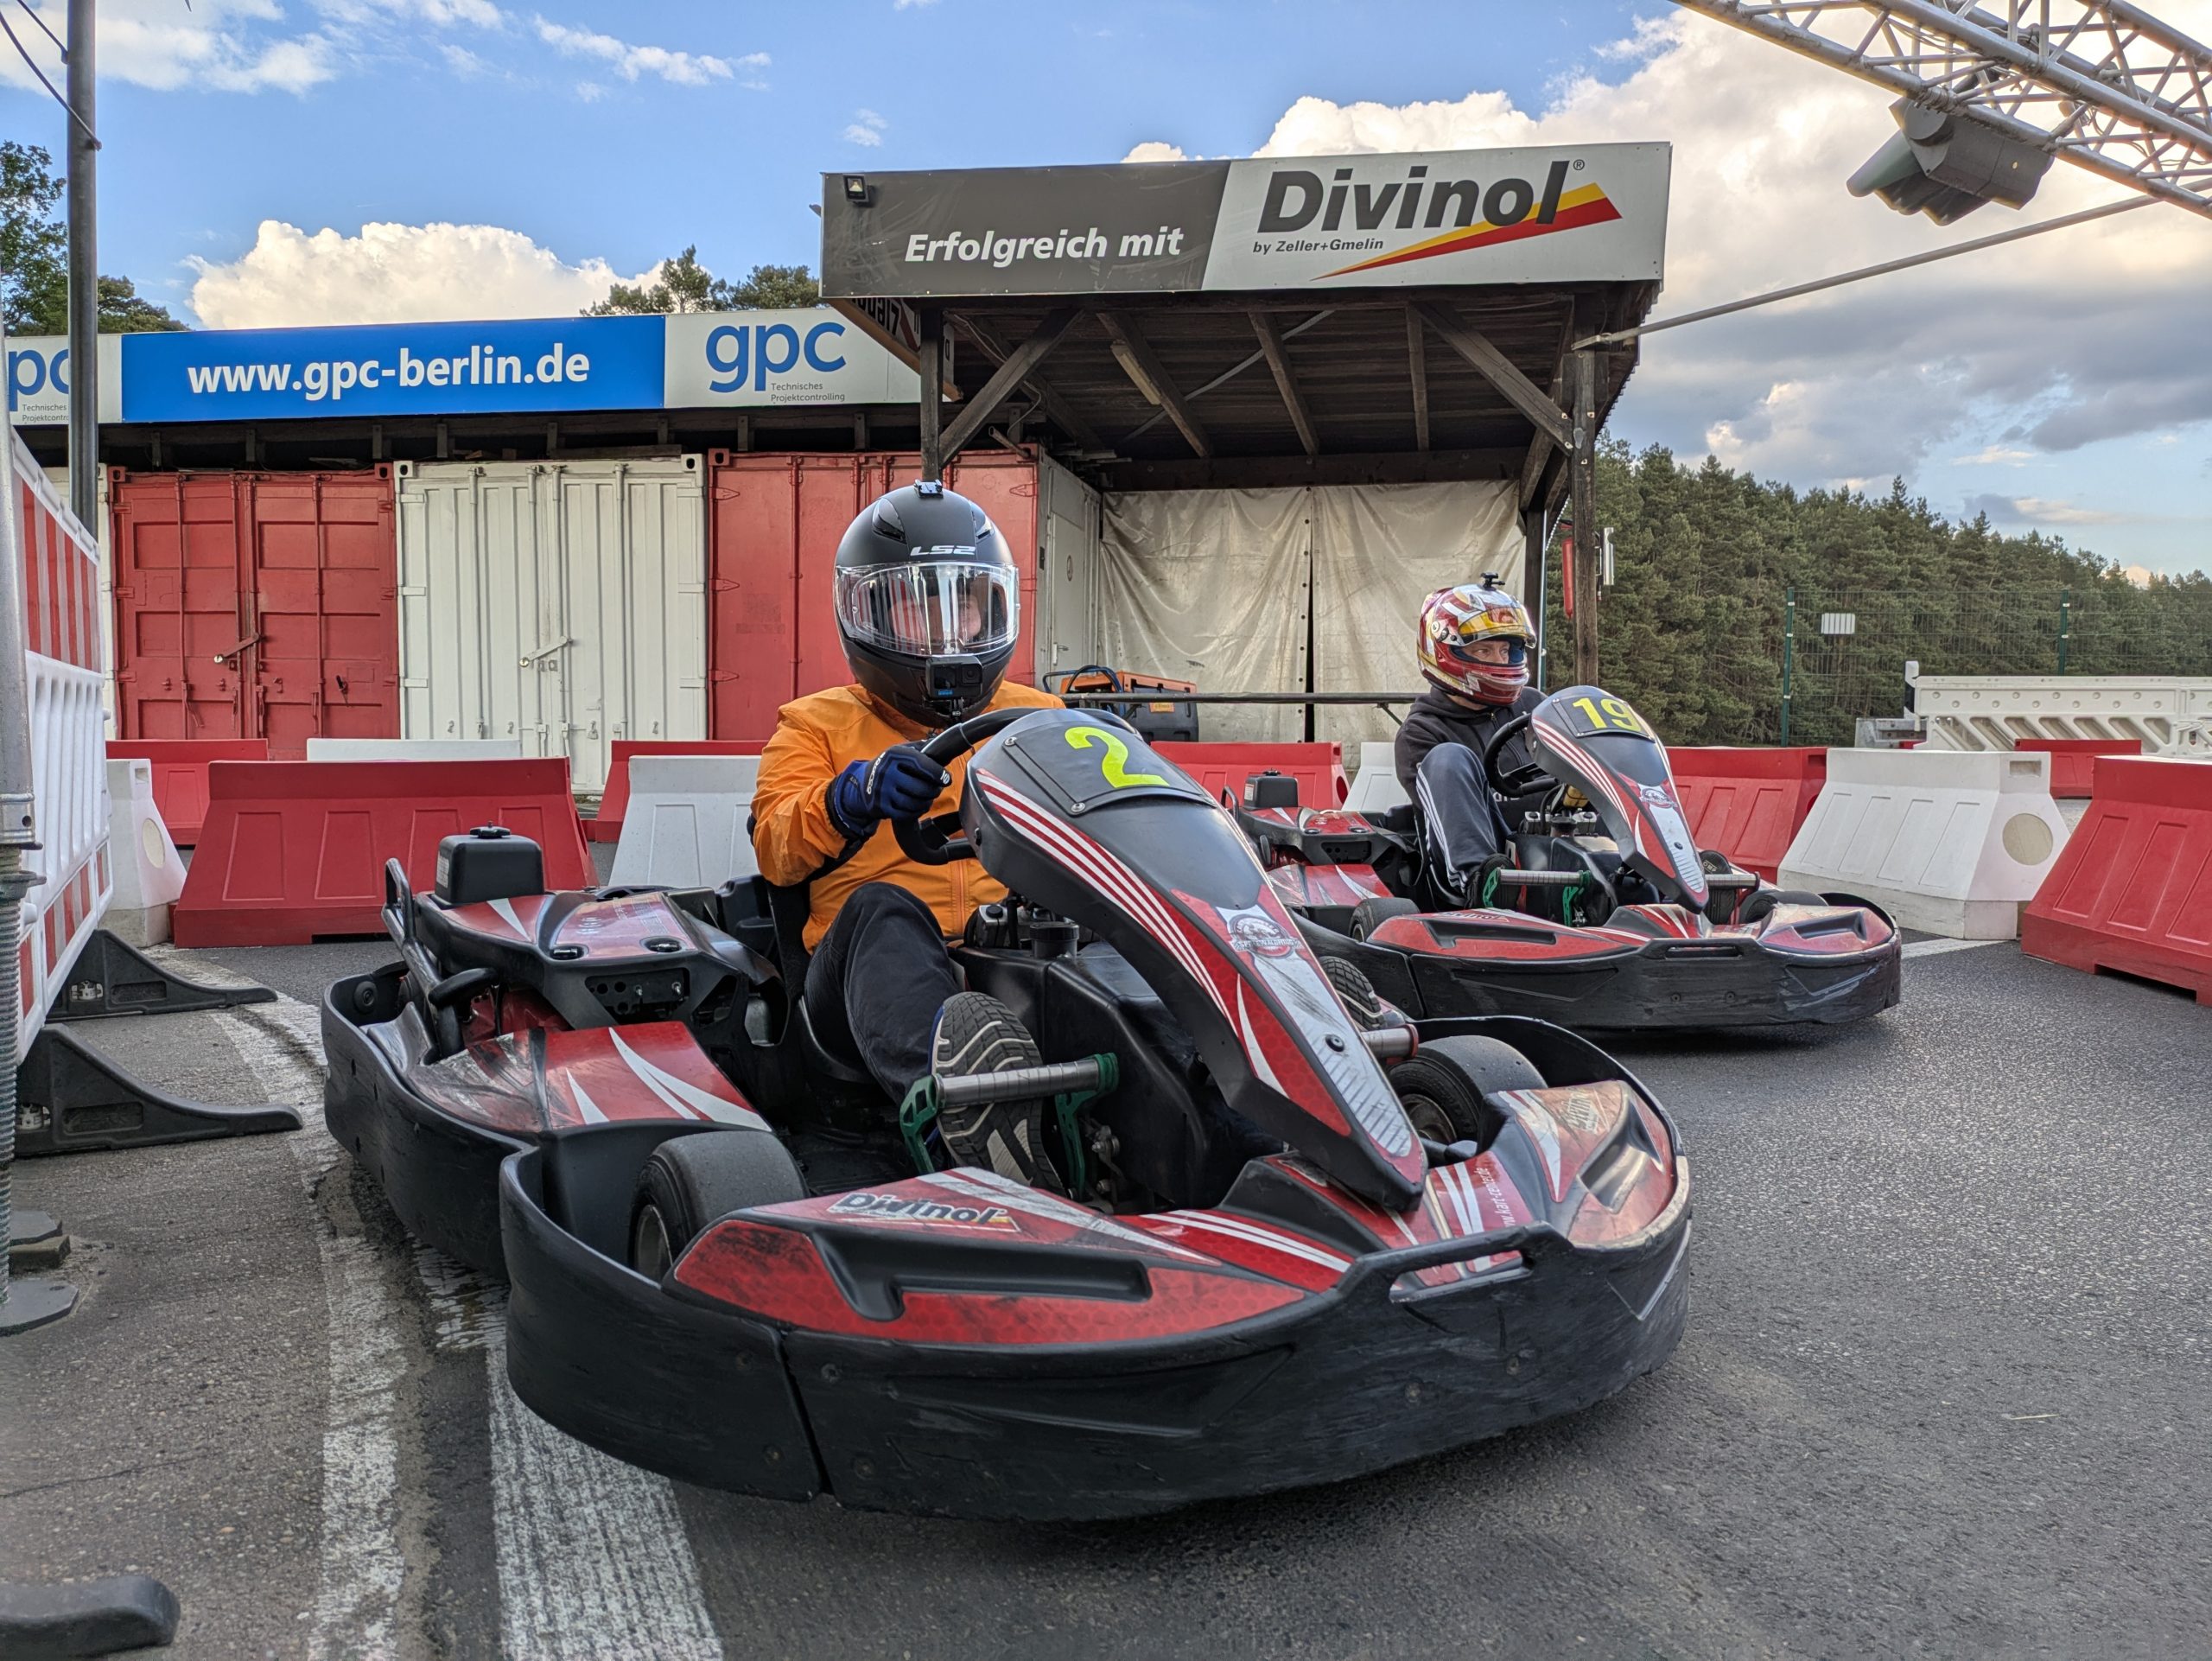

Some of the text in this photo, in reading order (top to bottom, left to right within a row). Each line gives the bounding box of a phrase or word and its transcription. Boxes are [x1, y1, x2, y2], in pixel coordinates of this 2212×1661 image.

[1257, 160, 1570, 233] Divinol
[905, 226, 1185, 267] Erfolgreich mit
[1253, 238, 1384, 255] by Zeller+Gmelin
[188, 342, 590, 401] www.gpc-berlin.de
[705, 321, 847, 393] gpc
[771, 382, 823, 391] Technisches
[771, 393, 846, 403] Projektcontrolling
[22, 404, 67, 412] Technisches
[910, 544, 976, 557] LS2
[1572, 697, 1642, 732] 19
[1064, 726, 1171, 788] 2
[832, 1193, 1007, 1224] Divinol
